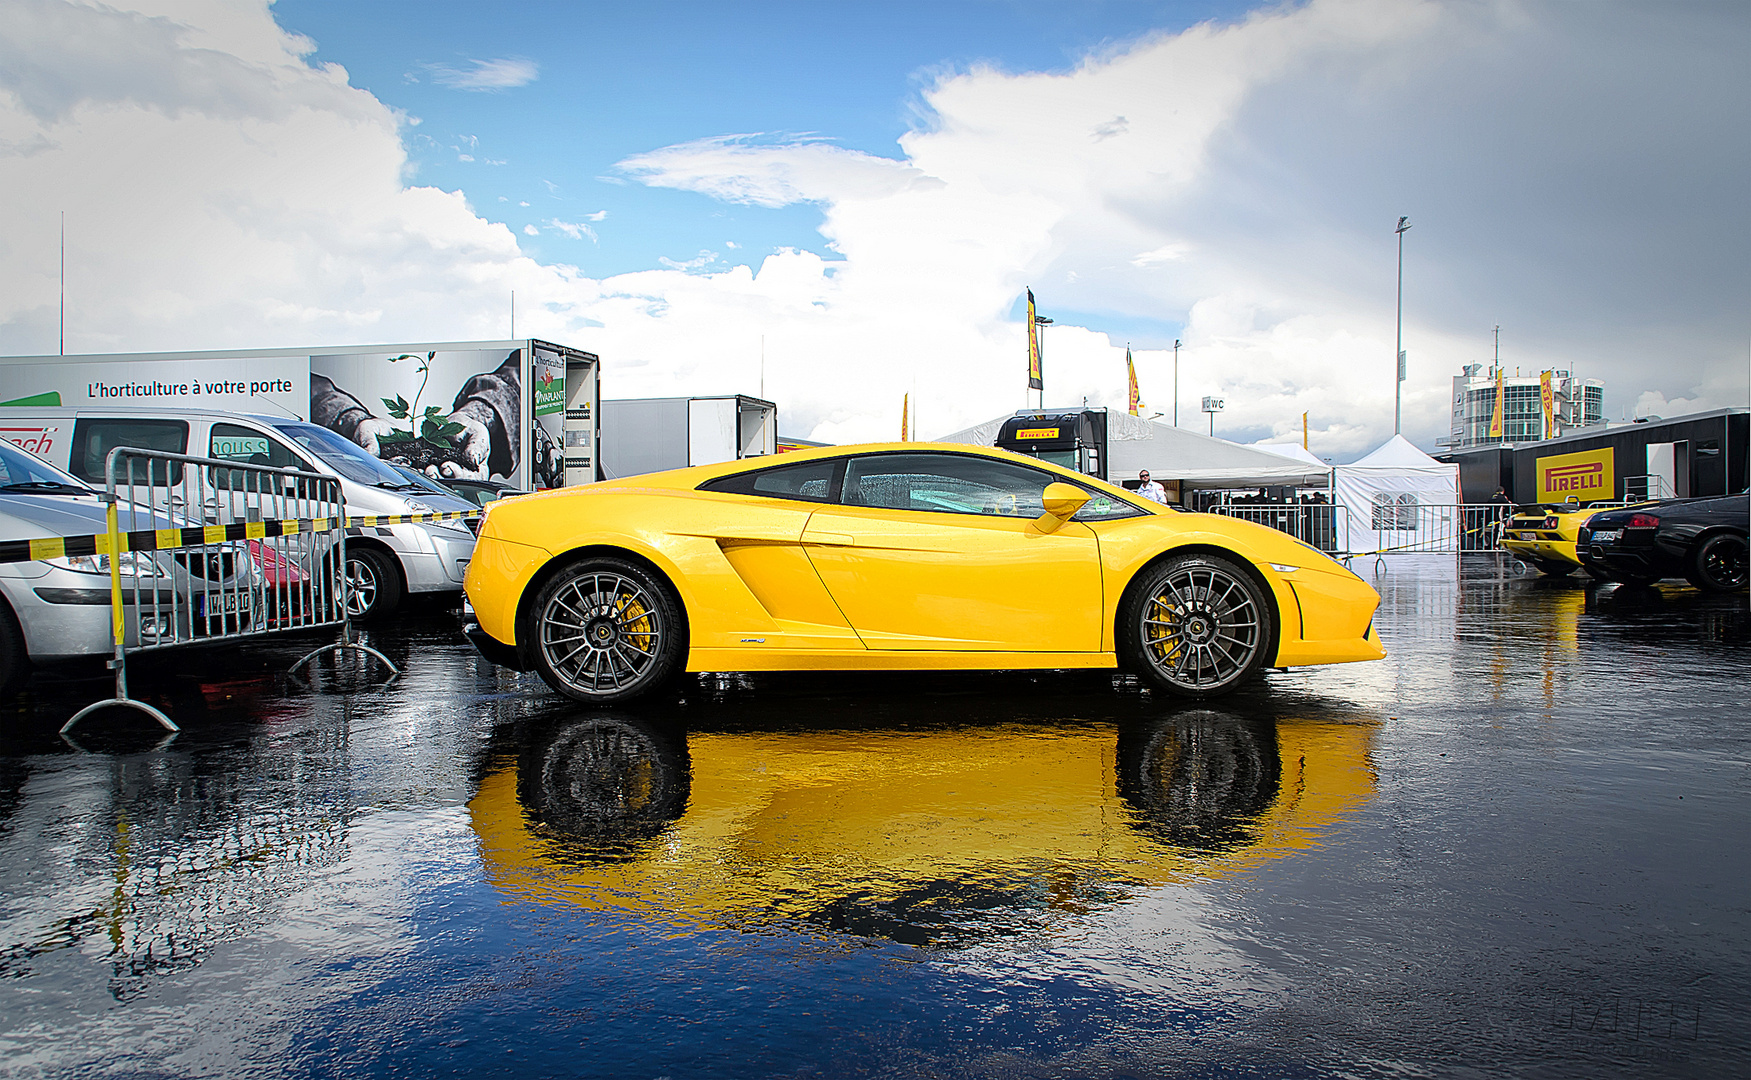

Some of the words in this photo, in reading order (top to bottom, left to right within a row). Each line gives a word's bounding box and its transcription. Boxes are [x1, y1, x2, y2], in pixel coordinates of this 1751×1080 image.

[88, 381, 188, 397] L'horticulture
[192, 379, 201, 394] à
[205, 381, 245, 394] votre
[250, 379, 292, 397] porte
[1211, 400, 1224, 409] WC
[1545, 462, 1603, 492] PIRELLI
